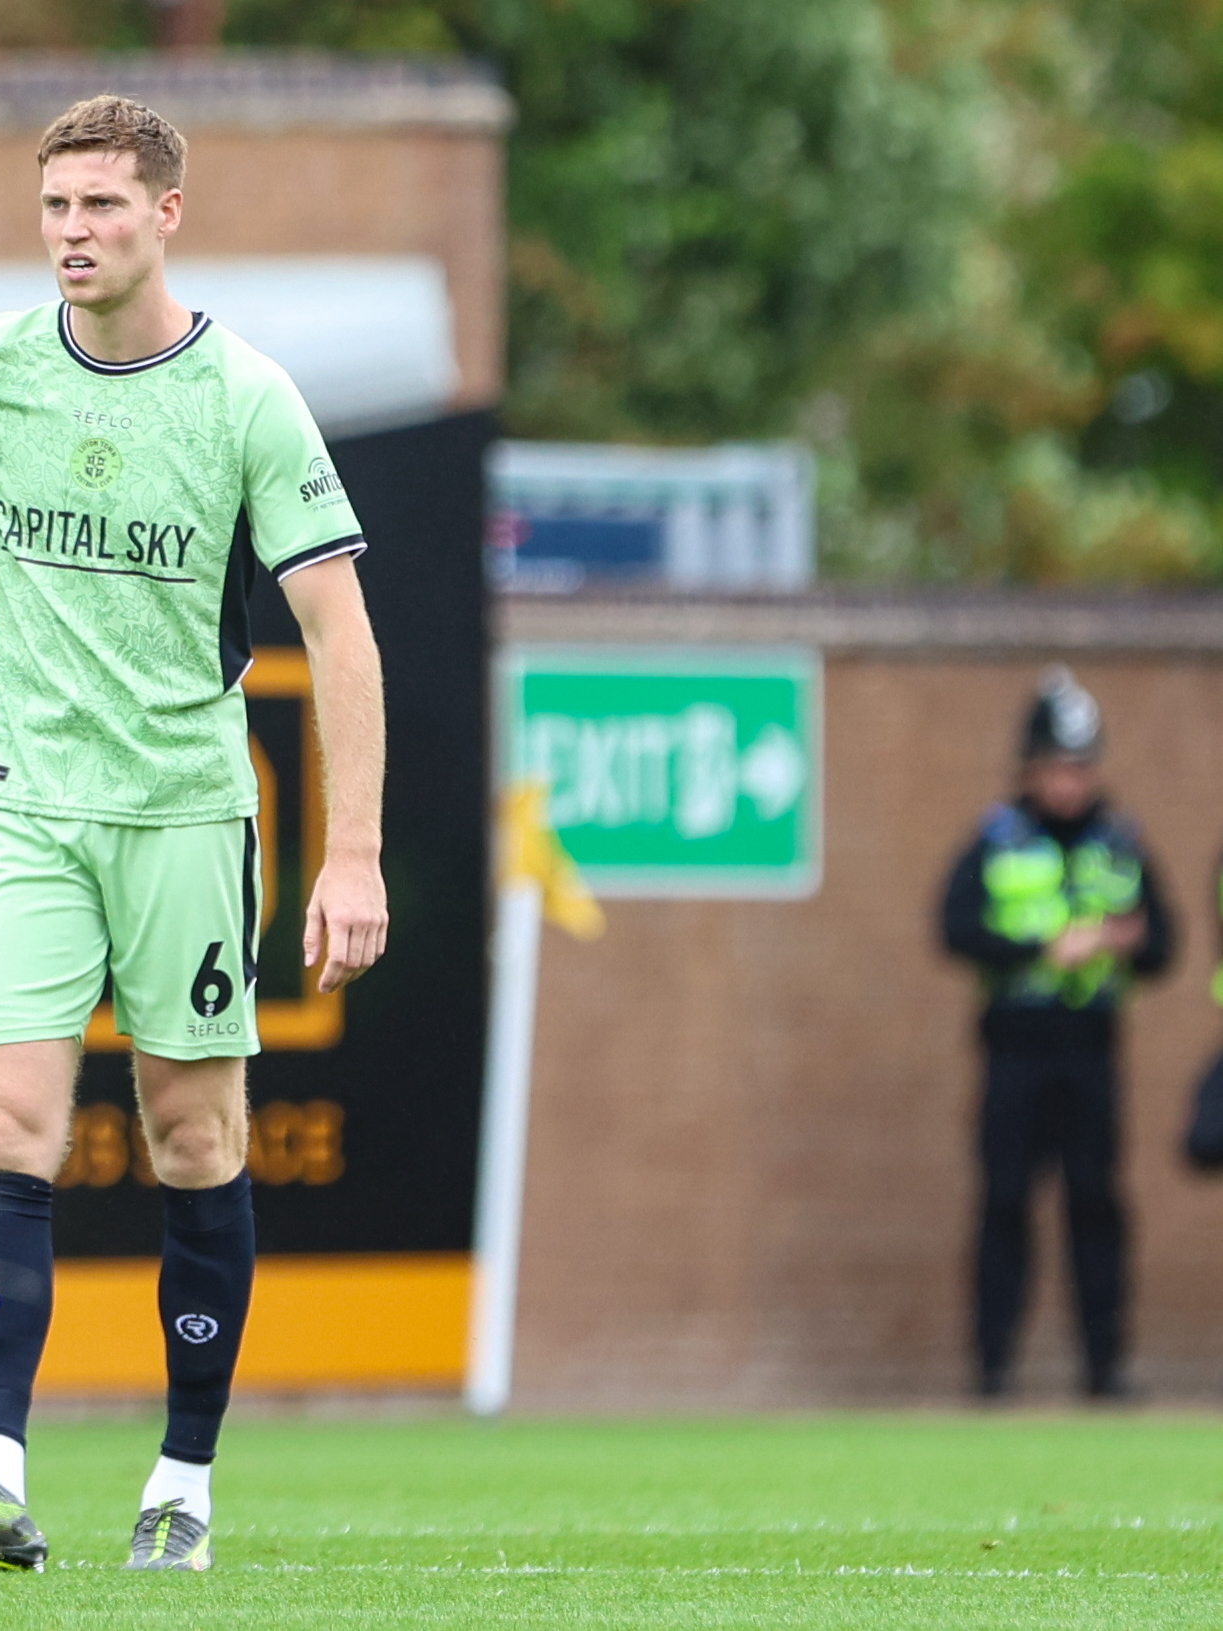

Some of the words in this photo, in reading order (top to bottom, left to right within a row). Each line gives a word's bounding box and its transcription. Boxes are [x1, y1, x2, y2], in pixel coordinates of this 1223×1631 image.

[73, 409, 133, 430] REFLO
[126, 520, 197, 568] SKY
[190, 940, 234, 1018] 6
[186, 1022, 240, 1037] REFLO
